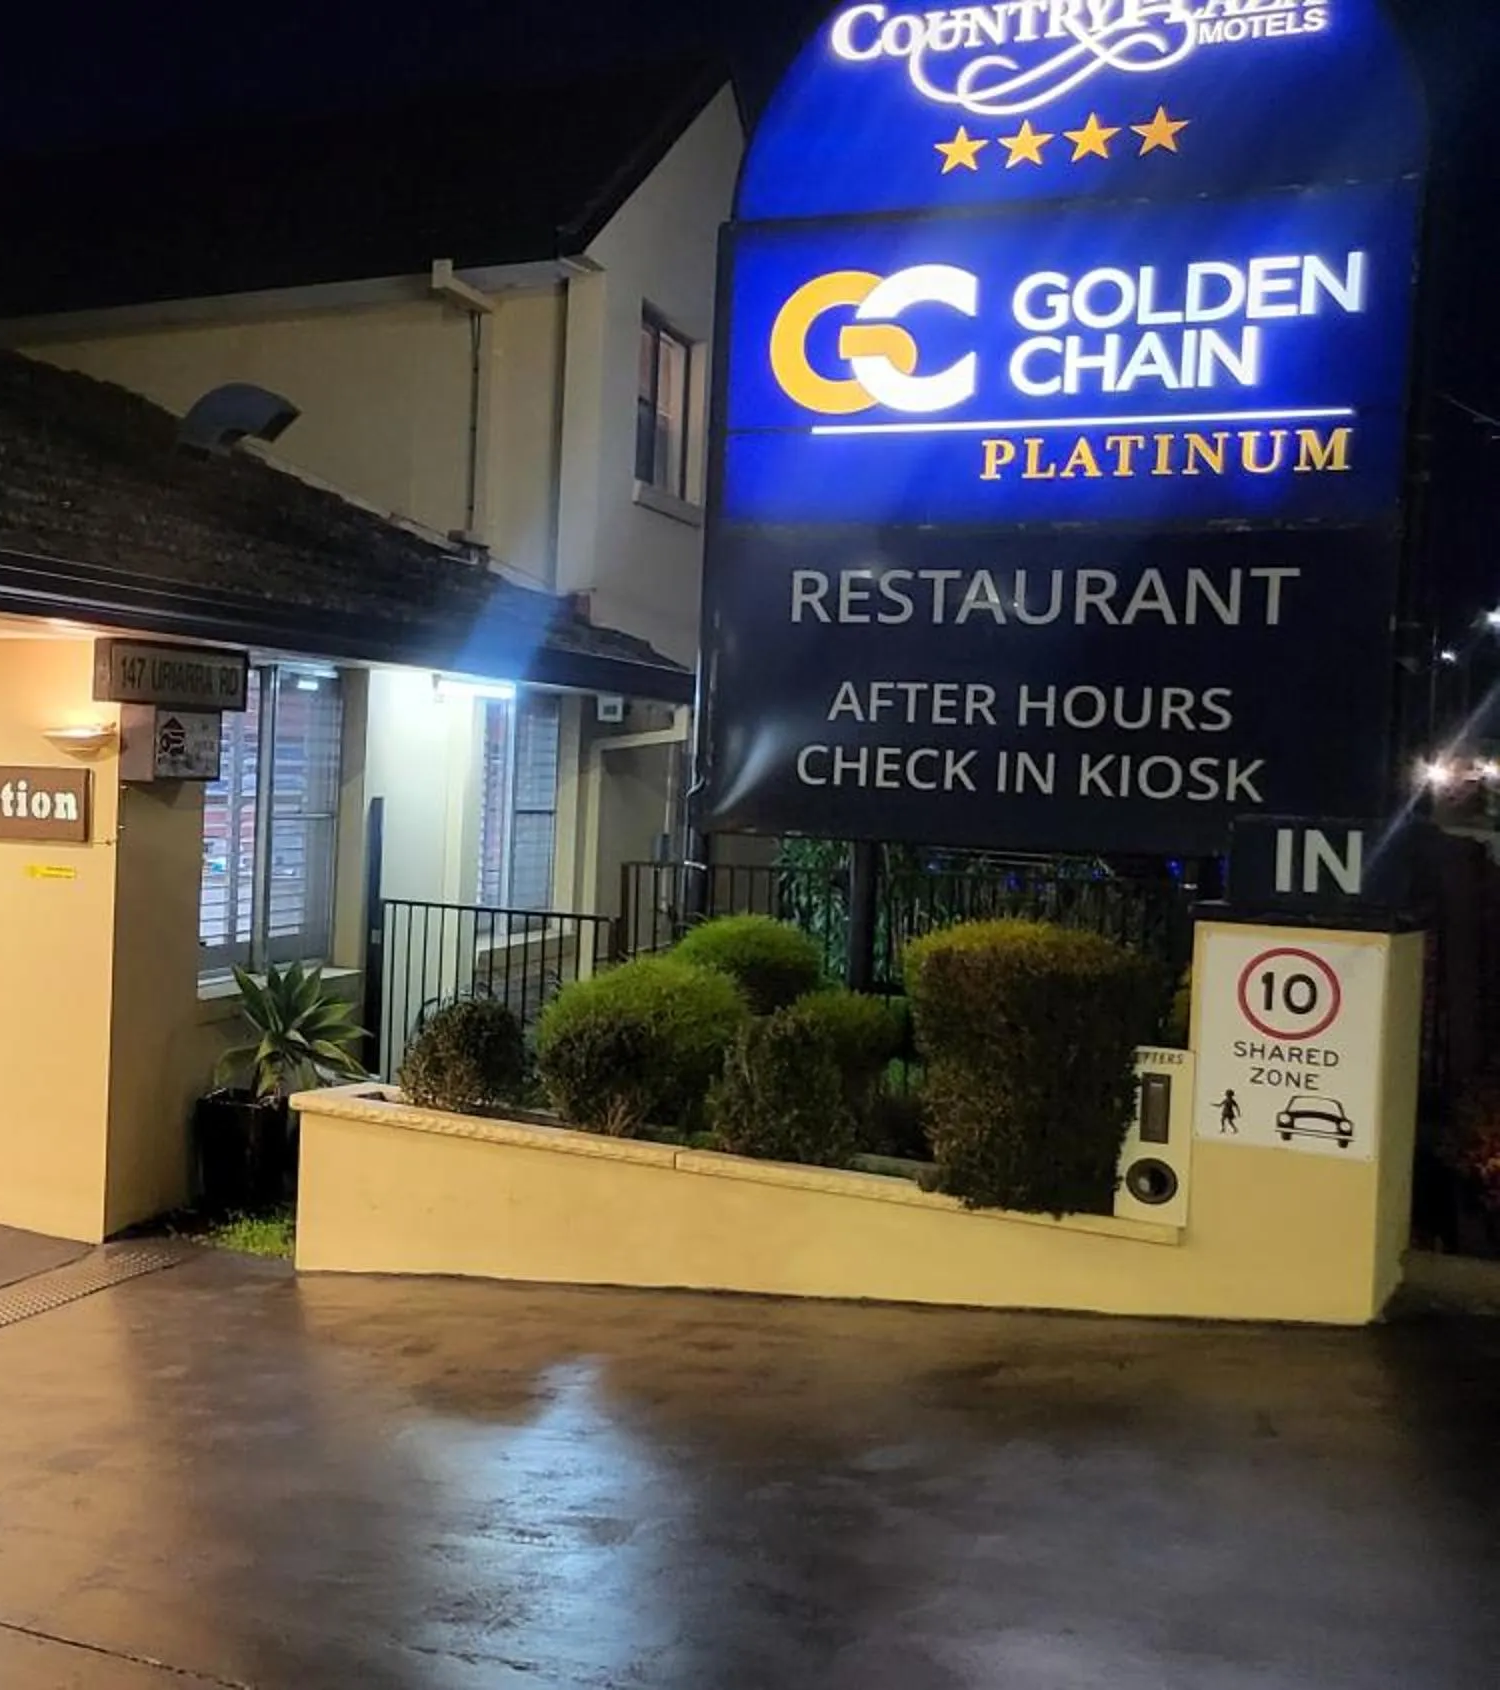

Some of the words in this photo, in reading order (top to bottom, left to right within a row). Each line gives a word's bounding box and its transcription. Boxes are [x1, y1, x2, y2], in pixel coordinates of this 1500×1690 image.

[1198, 7, 1328, 45] MOTELS
[1011, 251, 1365, 332] GOLDEN
[1008, 326, 1260, 396] CHAIN
[980, 428, 1353, 481] PLATINUM
[791, 567, 1301, 626] RESTAURANT
[120, 656, 146, 690] 147
[827, 680, 997, 726] AFTER
[1018, 685, 1233, 732] HOURS
[797, 745, 977, 792] CHECK
[997, 750, 1056, 794] IN
[1079, 754, 1266, 802] KIOSK
[1274, 829, 1364, 894] IN
[1261, 971, 1318, 1015] 10
[1233, 1040, 1340, 1069] SHARED
[1248, 1067, 1320, 1091] ZONE
